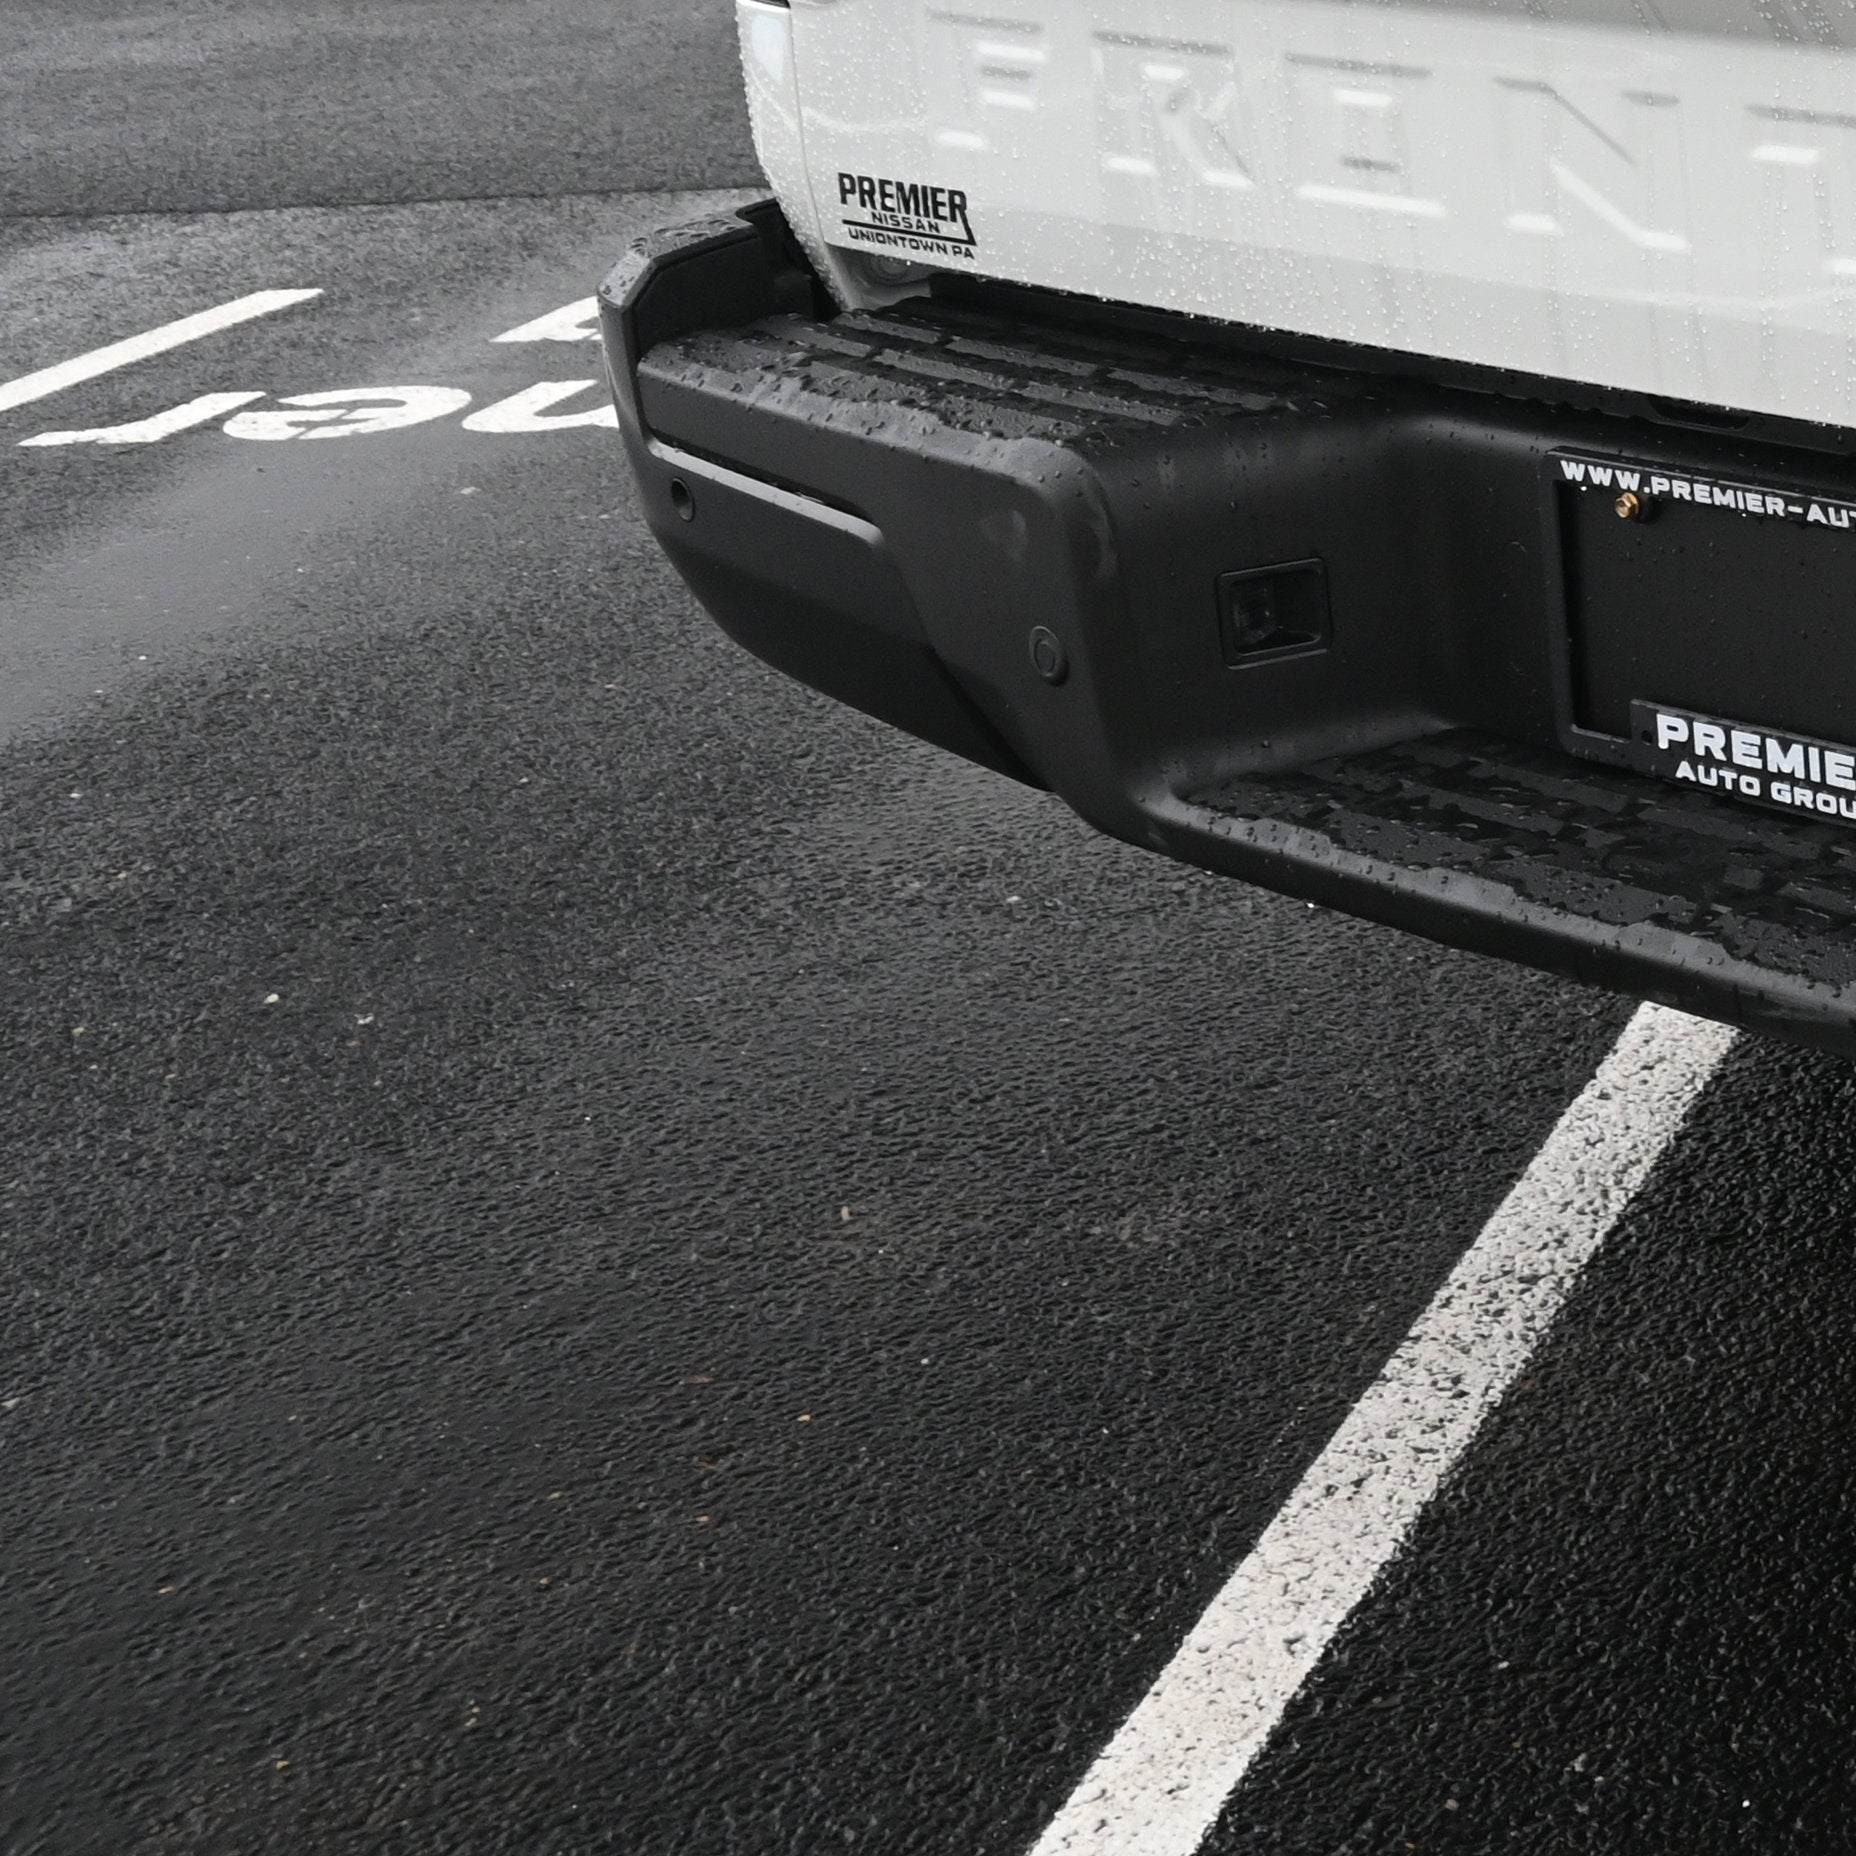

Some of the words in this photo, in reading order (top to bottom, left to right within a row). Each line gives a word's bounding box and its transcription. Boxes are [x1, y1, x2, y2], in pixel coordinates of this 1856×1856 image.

[837, 172, 972, 230] PREMIER
[871, 211, 941, 234] NISSAN
[848, 227, 949, 256] UNIONTOWN
[952, 244, 976, 260] PA
[1675, 760, 1761, 797] AUTO
